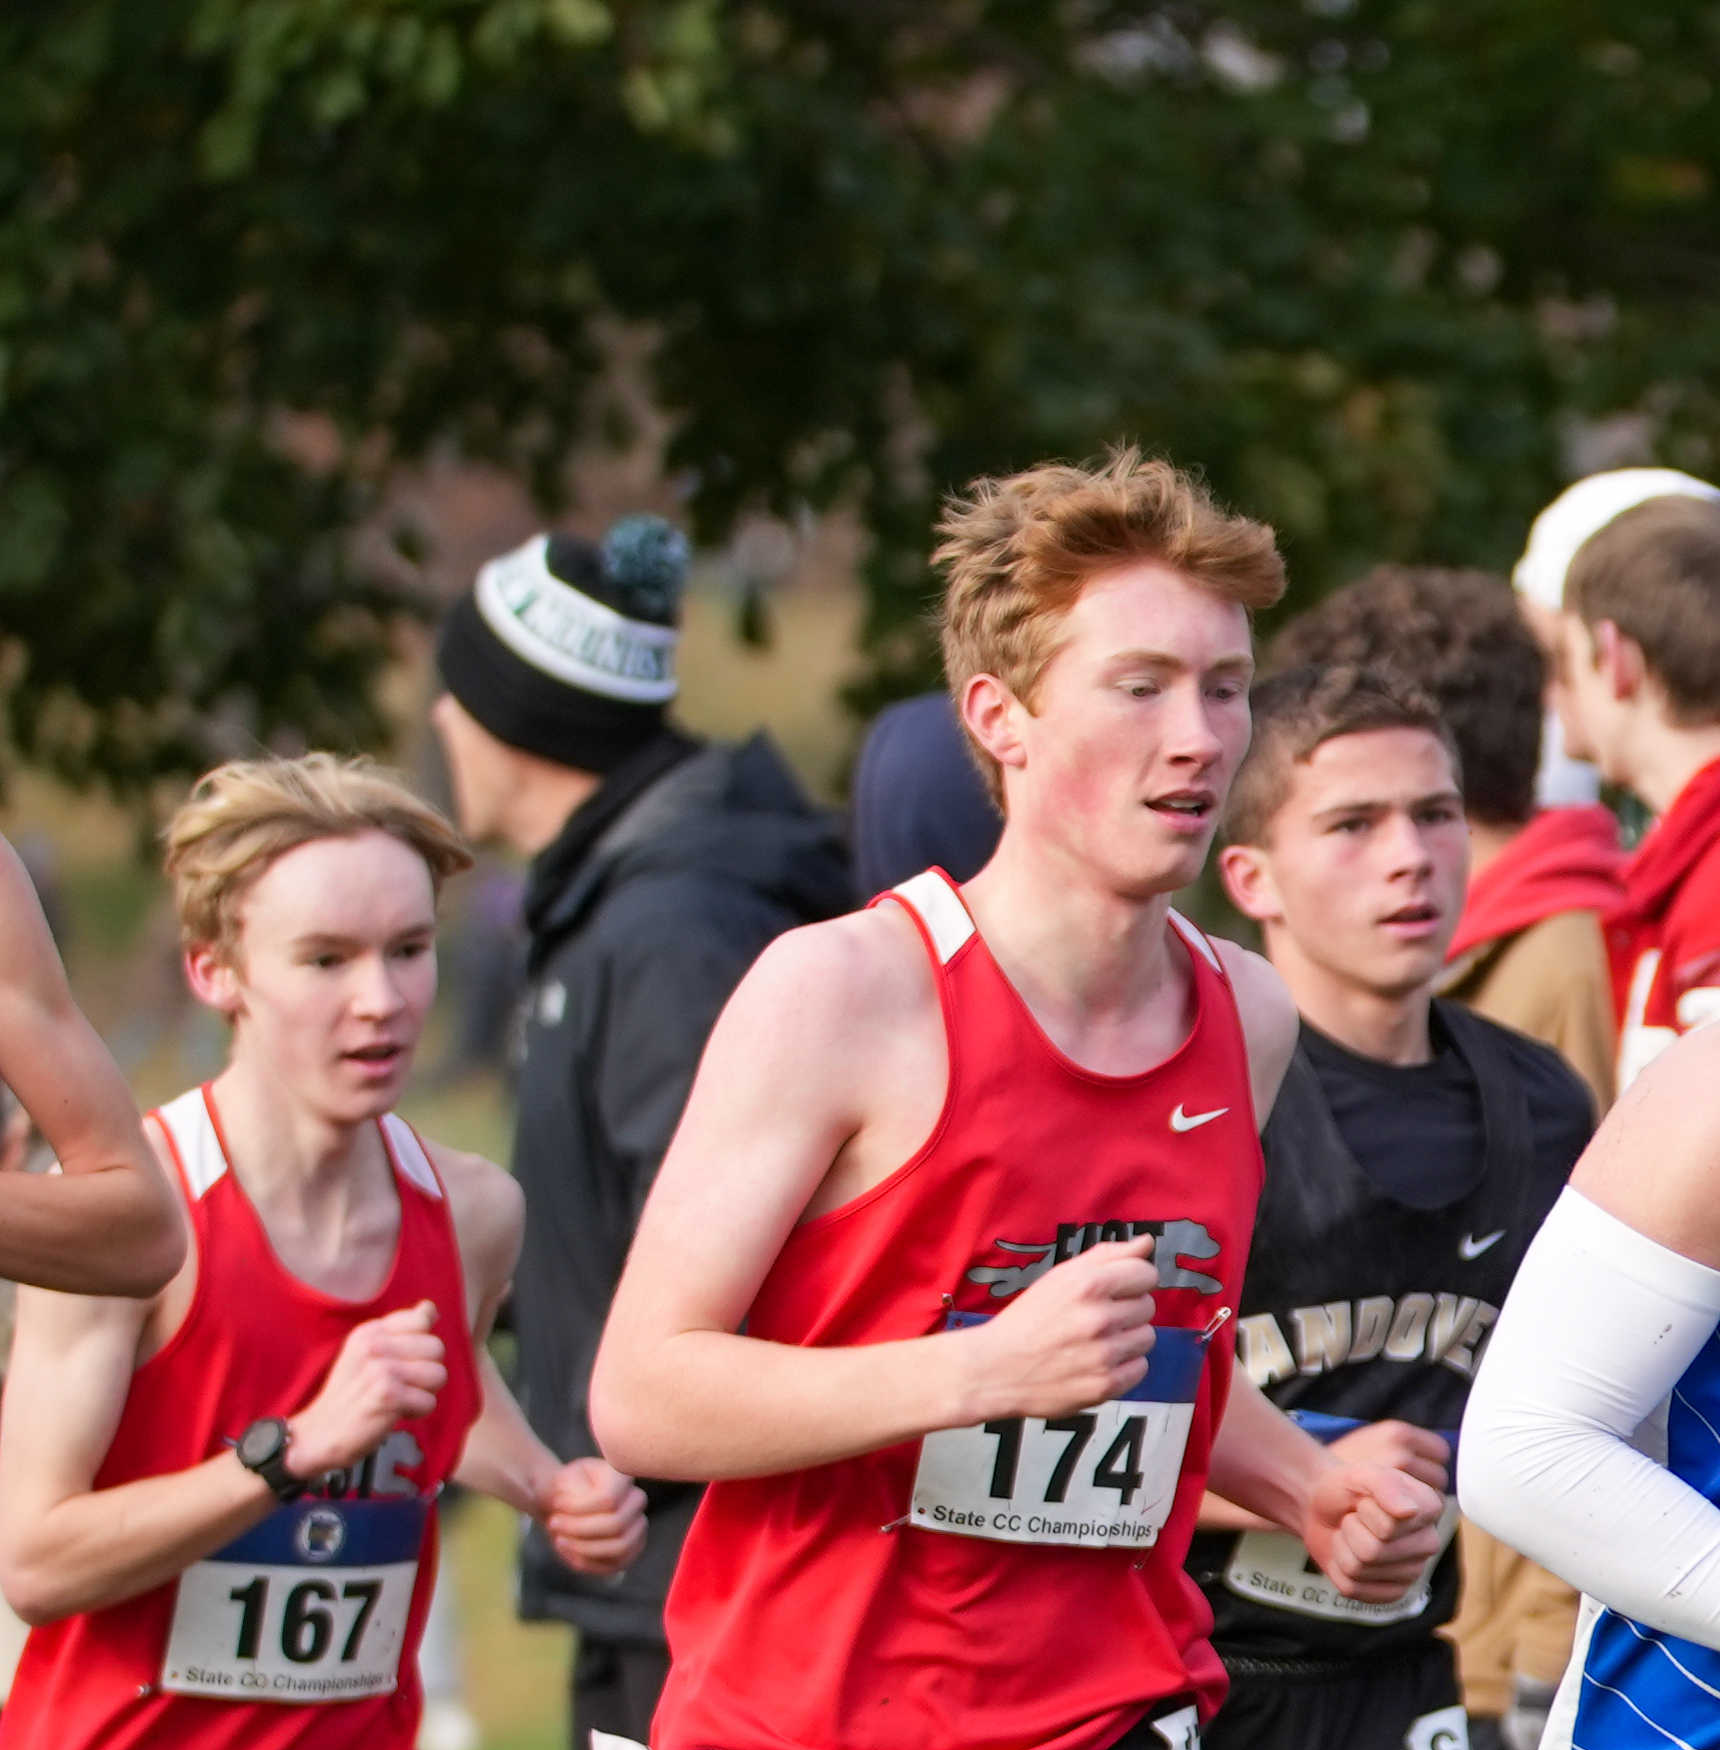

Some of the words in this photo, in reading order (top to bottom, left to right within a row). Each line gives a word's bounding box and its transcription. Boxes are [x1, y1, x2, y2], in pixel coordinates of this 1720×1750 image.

[984, 1413, 1149, 1506] 174
[933, 1504, 986, 1528] State
[992, 1513, 1022, 1532] CC
[1250, 1571, 1296, 1596] State
[1300, 1586, 1329, 1604] CC
[229, 1574, 385, 1665] 167
[186, 1666, 233, 1686] State
[273, 1672, 384, 1695] Championships
